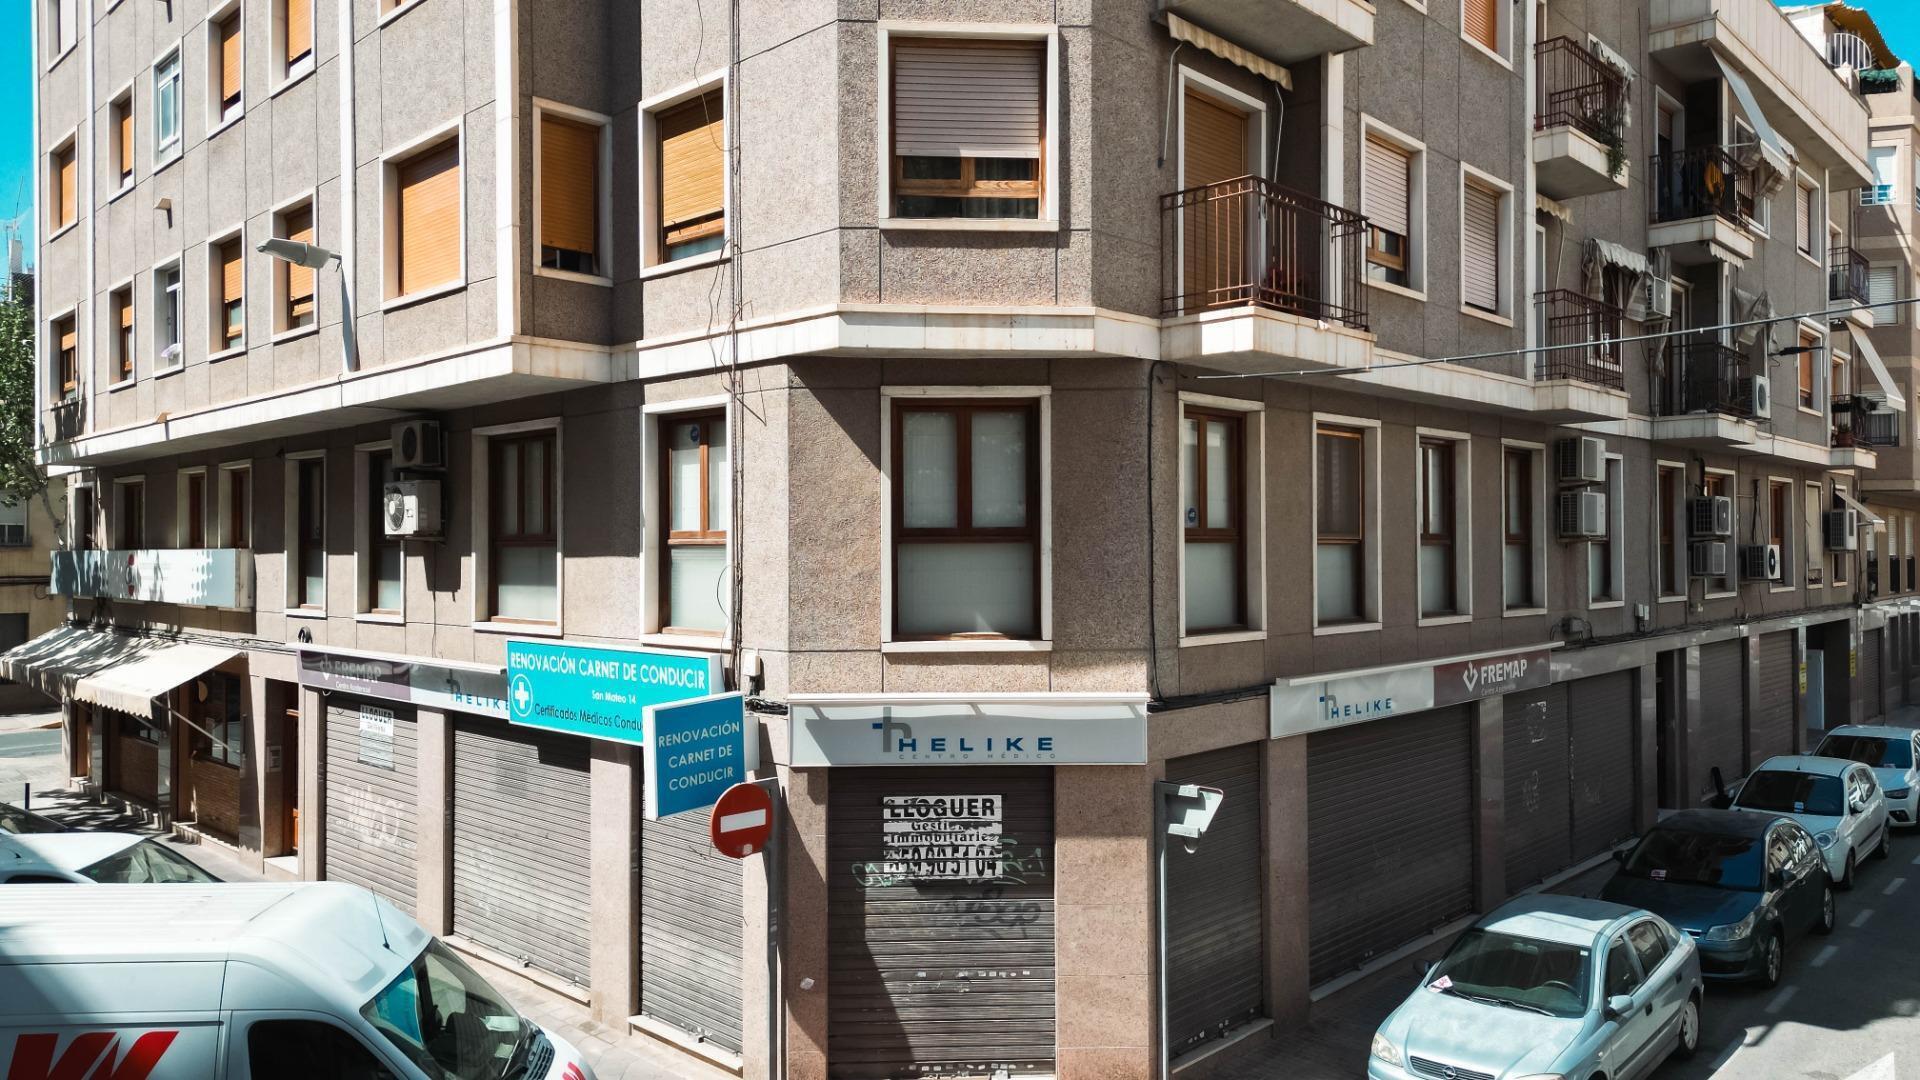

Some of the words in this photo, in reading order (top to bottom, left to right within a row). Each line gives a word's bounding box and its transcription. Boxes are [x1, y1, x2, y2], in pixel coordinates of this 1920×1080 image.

[510, 651, 576, 675] RENOVACIÓN
[579, 658, 620, 680] CARNET
[622, 662, 637, 682] DE
[640, 664, 706, 689] CONDUCIR
[1481, 659, 1528, 685] FREMAP
[455, 692, 509, 711] HELIKE
[591, 689, 604, 701] San
[605, 691, 627, 704] Mateo
[628, 694, 637, 705] 14
[1331, 697, 1392, 719] HELIKE
[534, 703, 578, 721] Certificados
[613, 714, 643, 731] Condu
[658, 719, 741, 748] RENOVACIÓN
[898, 737, 1054, 752] HELIKE
[668, 748, 715, 768] CARNET
[718, 744, 733, 758] DE
[668, 766, 734, 791] CONDUCIR
